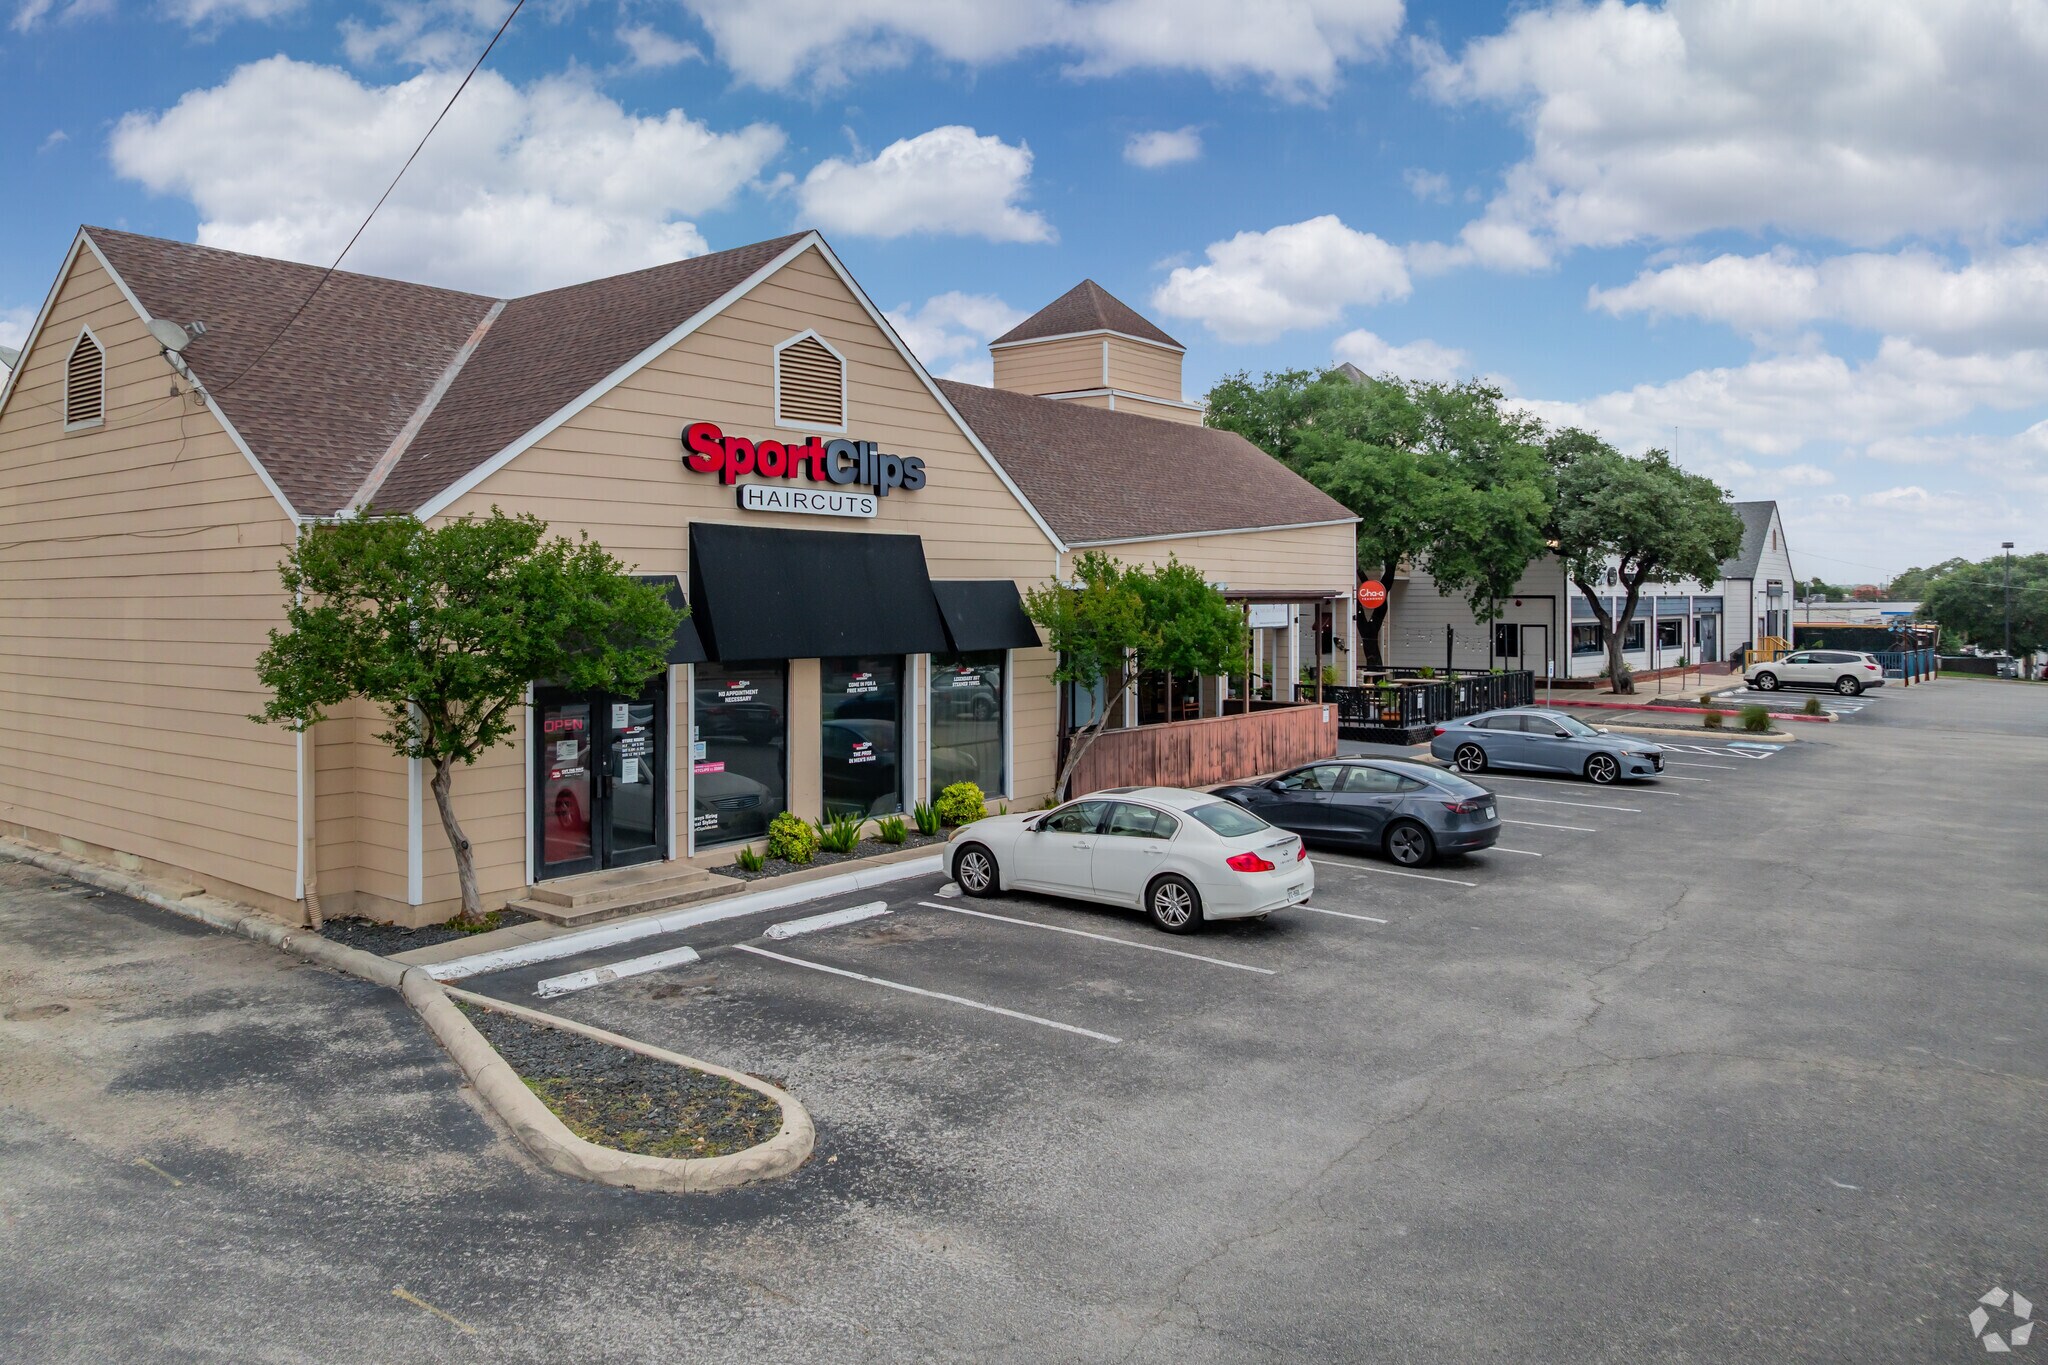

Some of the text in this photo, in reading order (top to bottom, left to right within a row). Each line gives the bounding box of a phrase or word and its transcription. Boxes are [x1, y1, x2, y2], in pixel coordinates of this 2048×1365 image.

[749, 489, 873, 514] HAIRCUTS
[1359, 588, 1384, 597] Cha-a
[544, 719, 583, 733] OPEN
